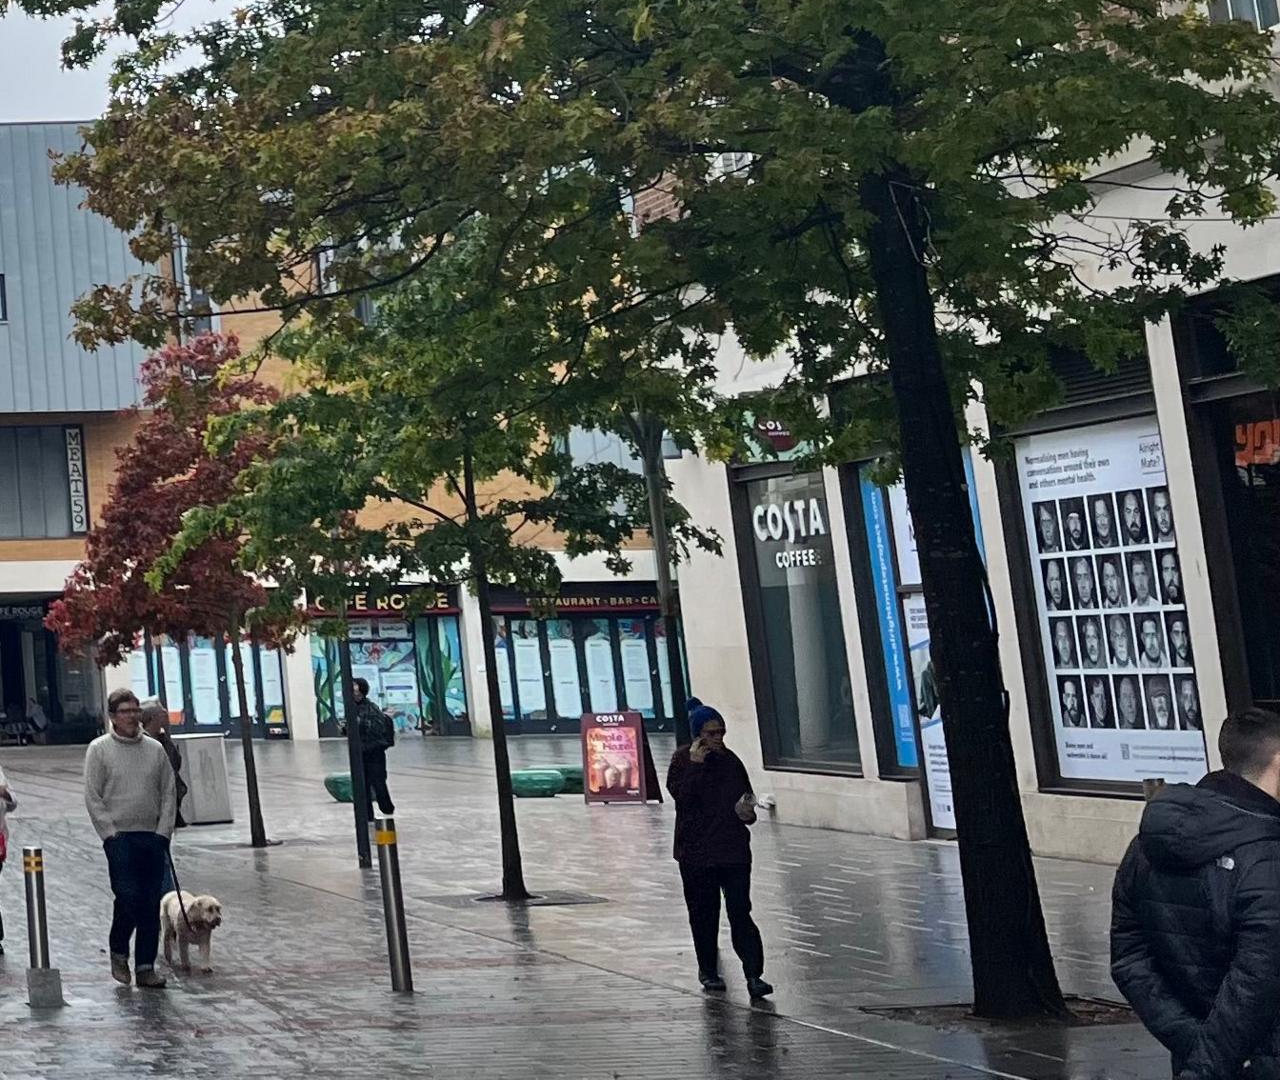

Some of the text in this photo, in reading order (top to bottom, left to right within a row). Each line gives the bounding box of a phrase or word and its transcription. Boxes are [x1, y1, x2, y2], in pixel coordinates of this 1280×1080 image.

[753, 497, 825, 544] COSTA
[775, 548, 816, 569] COFFEE
[609, 596, 632, 606] BAR
[596, 715, 624, 723] COSTA
